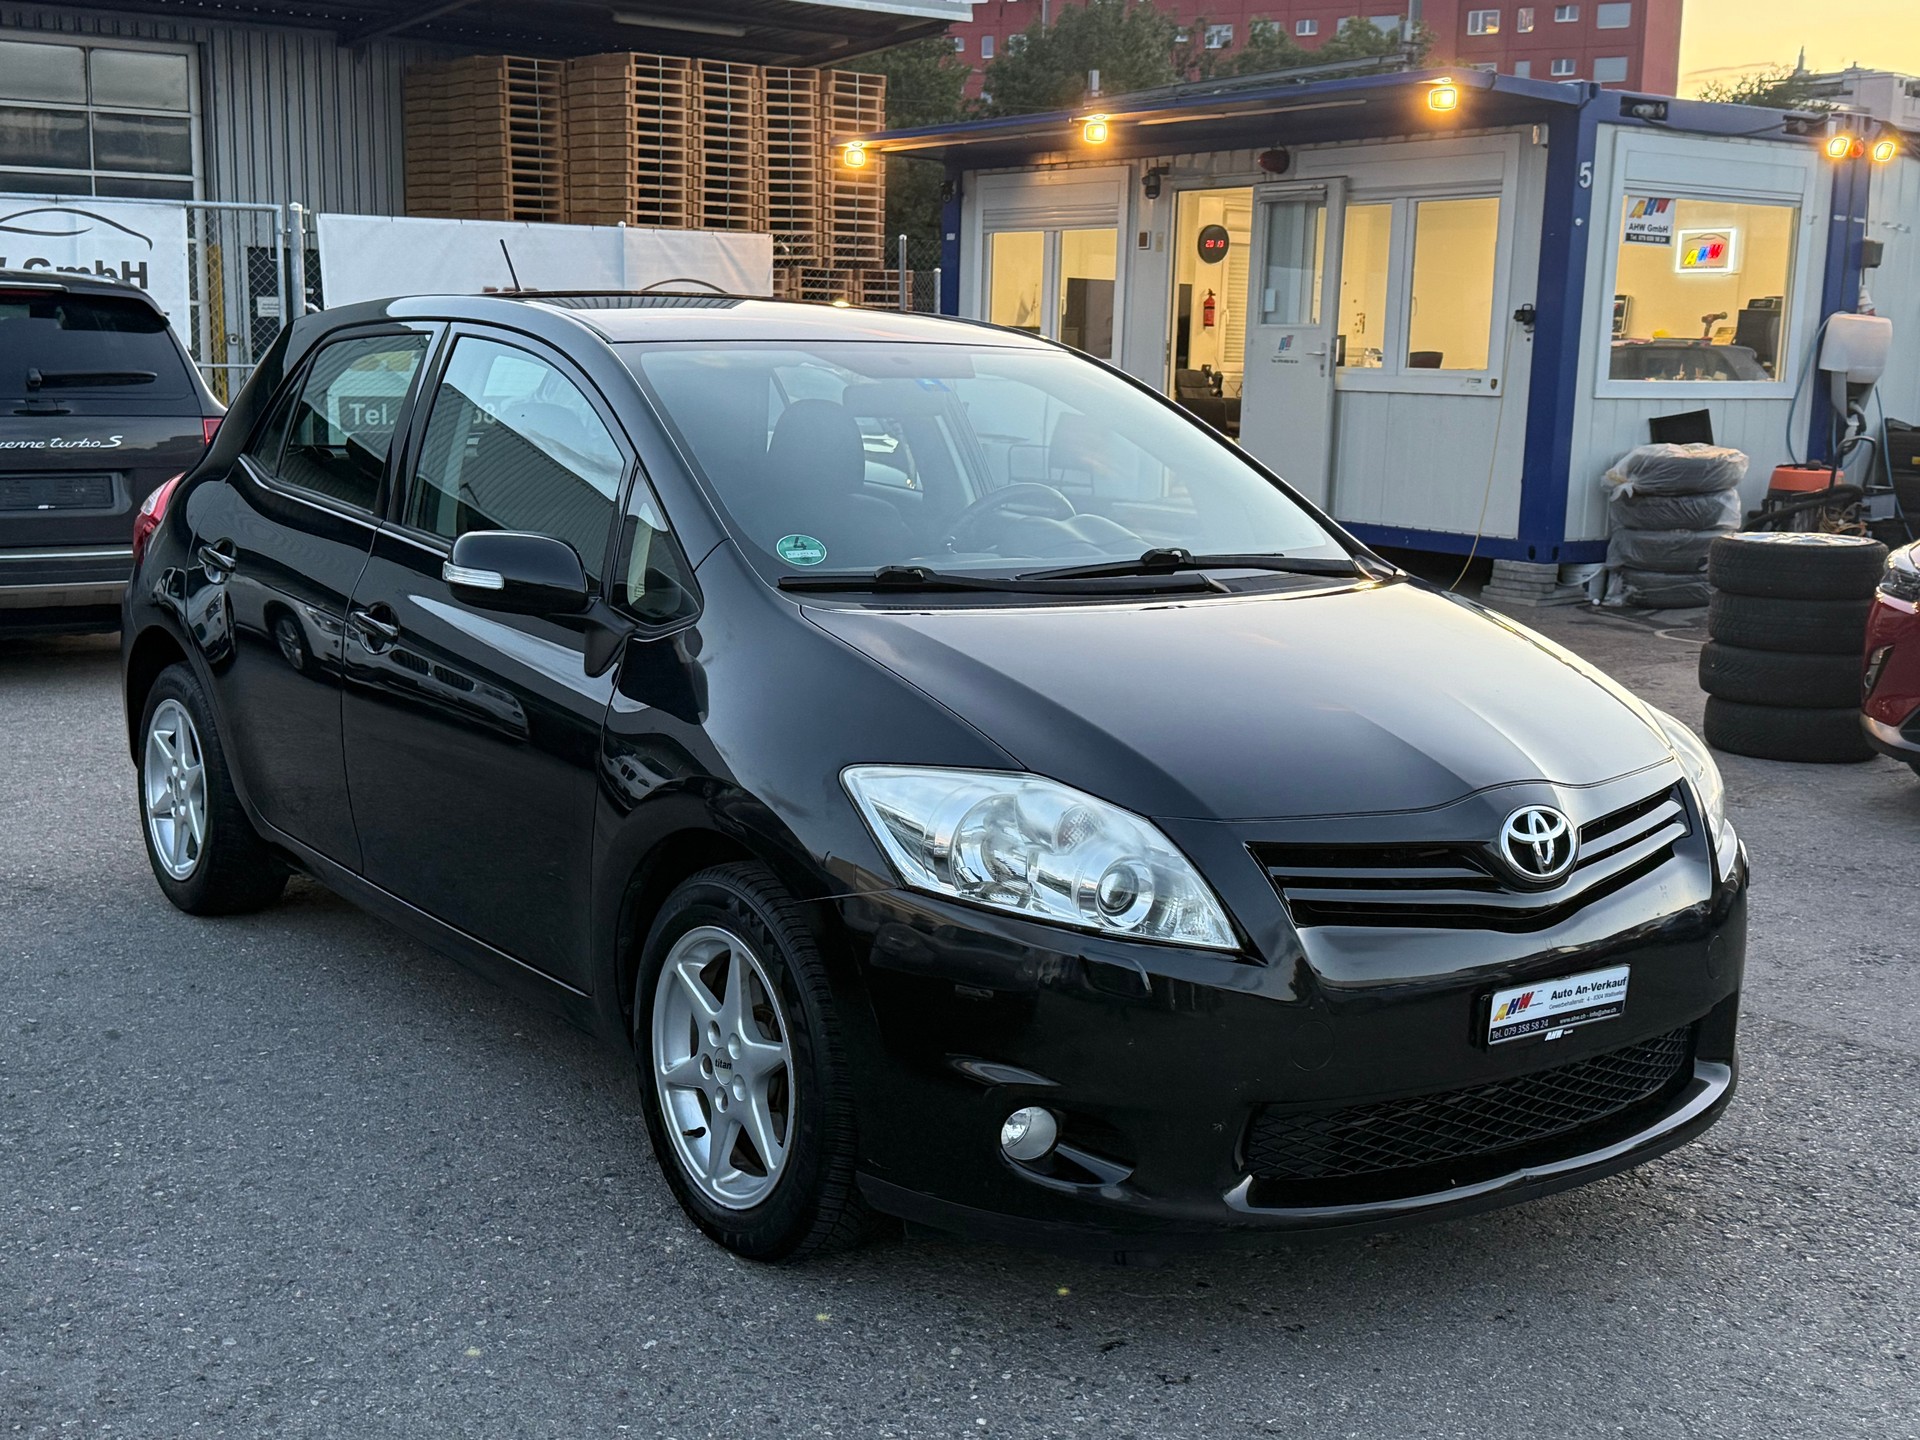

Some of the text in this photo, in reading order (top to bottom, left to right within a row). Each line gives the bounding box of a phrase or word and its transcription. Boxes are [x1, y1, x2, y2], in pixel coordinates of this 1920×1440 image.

[1579, 161, 1592, 189] 5
[1629, 223, 1669, 233] AHW GmbH
[1683, 243, 1724, 265] AHW
[349, 403, 395, 426] Tel.
[50, 437, 101, 449] turbo
[793, 536, 807, 550] 4
[1551, 976, 1627, 1001] Auto An-Verkauf
[1493, 991, 1535, 1022] AHW
[1504, 1026, 1516, 1037] 079
[1540, 1019, 1549, 1029] 24
[715, 1058, 732, 1070] titan
